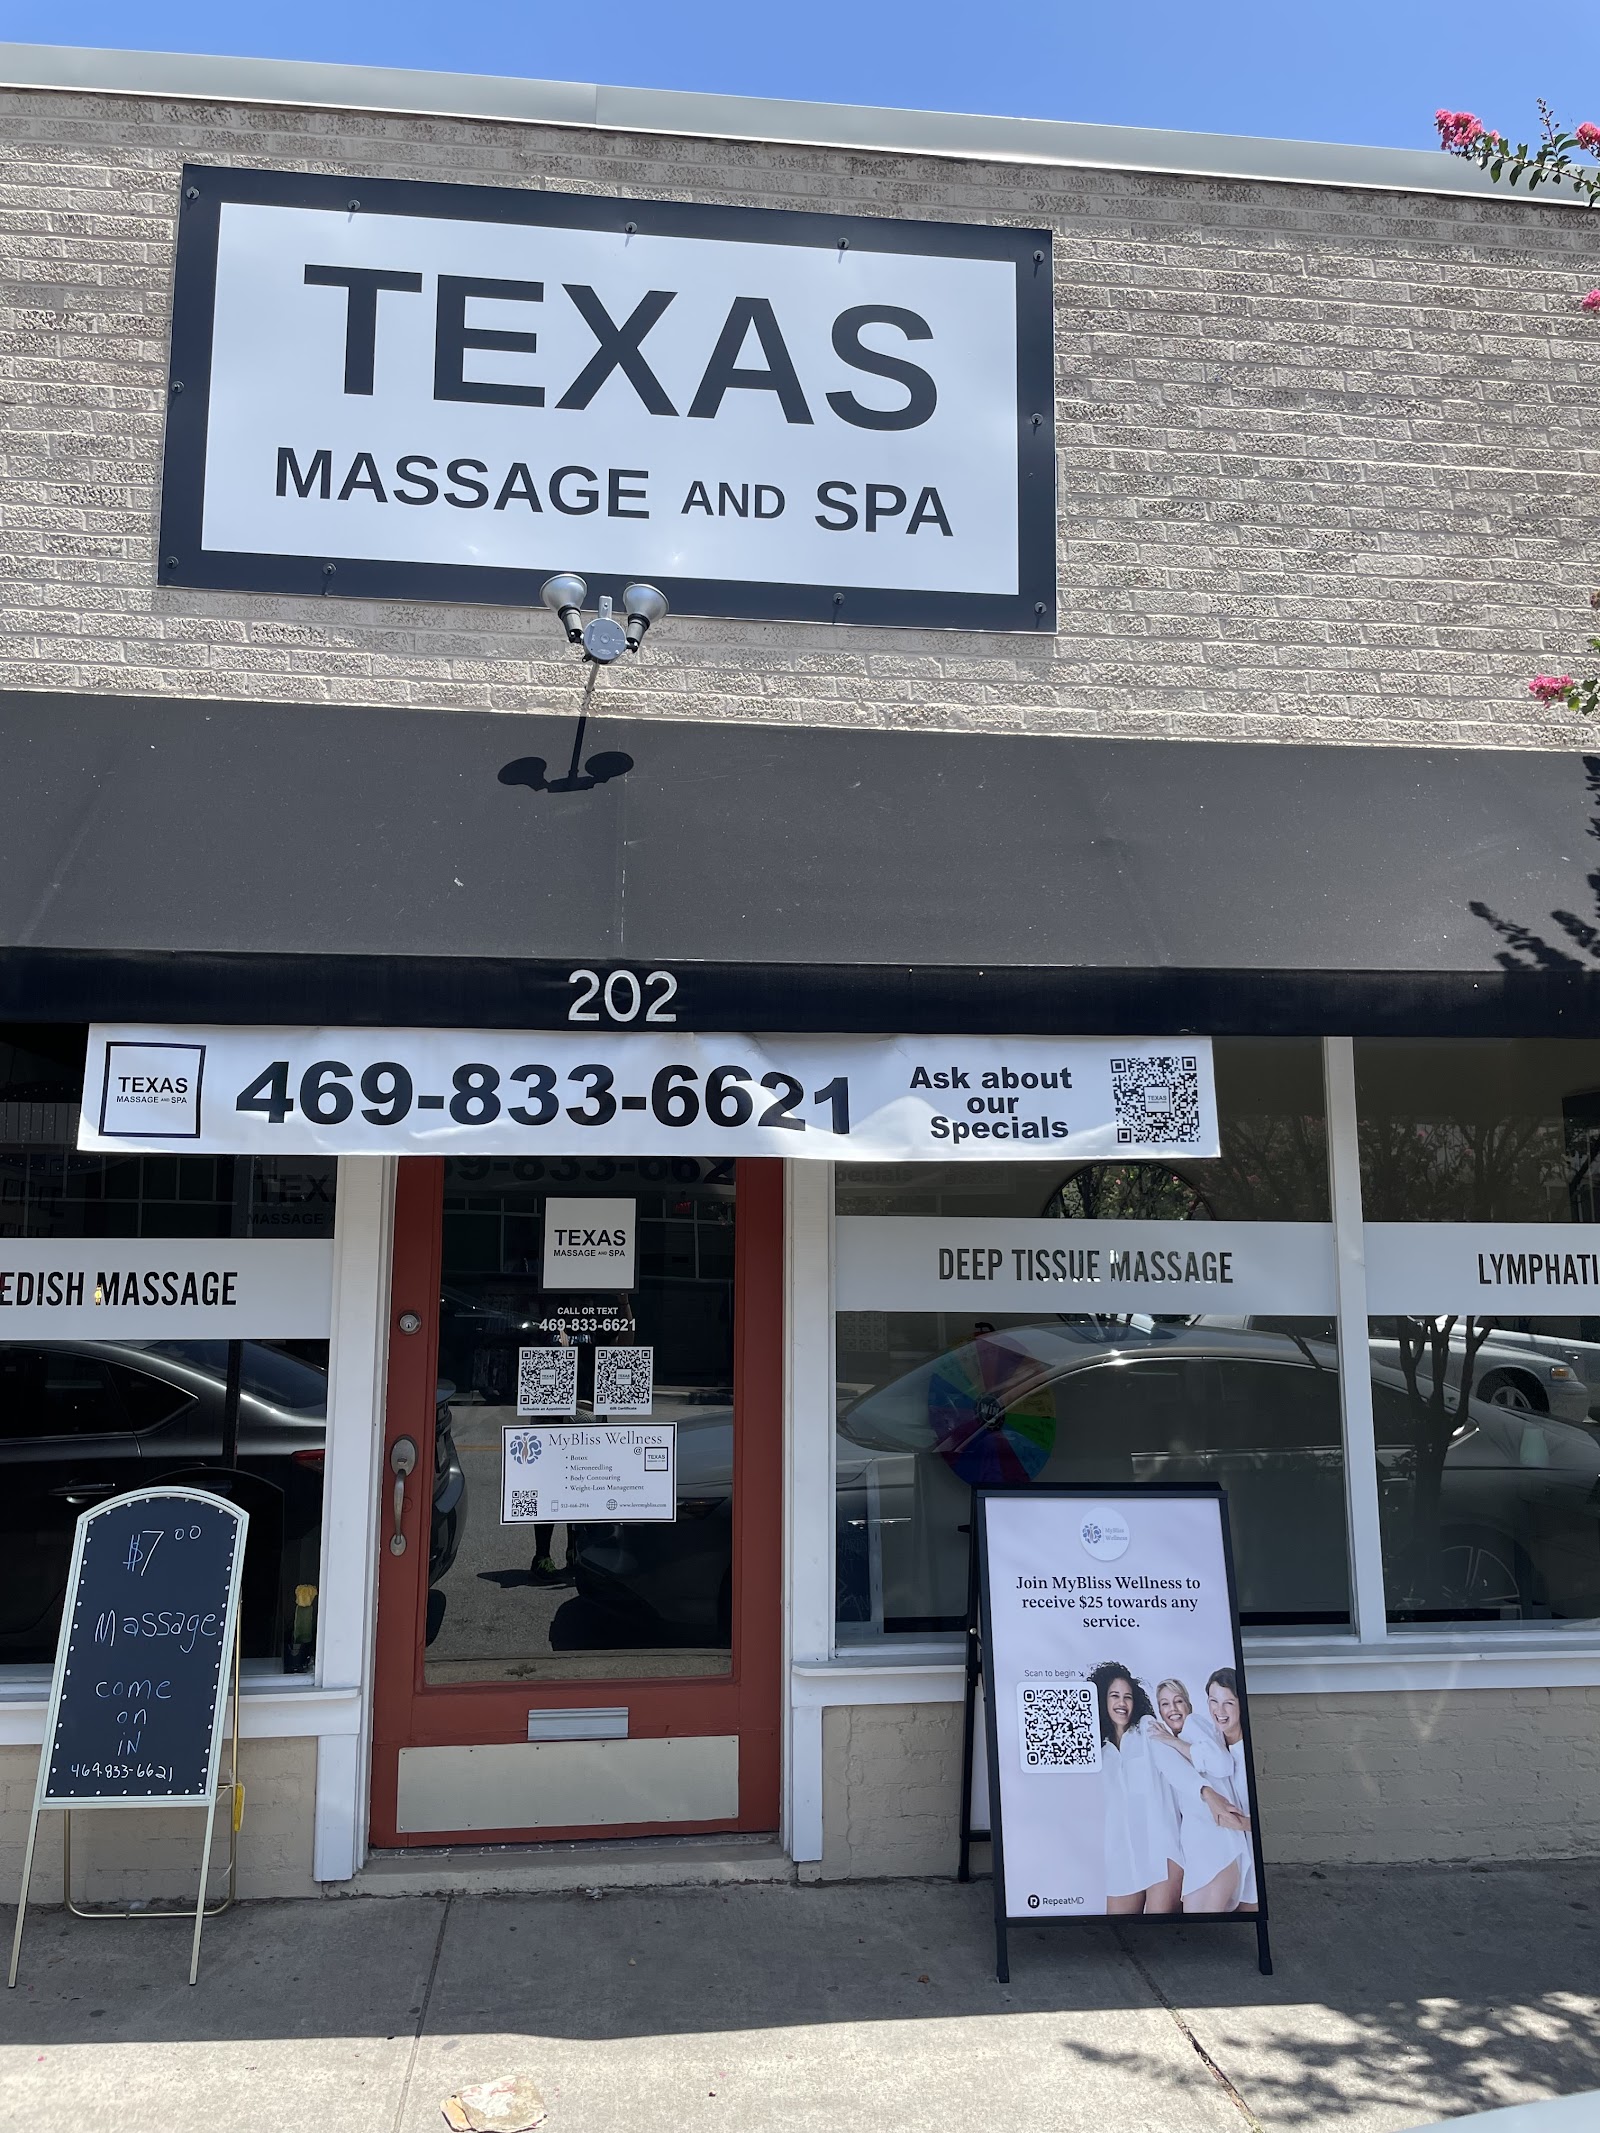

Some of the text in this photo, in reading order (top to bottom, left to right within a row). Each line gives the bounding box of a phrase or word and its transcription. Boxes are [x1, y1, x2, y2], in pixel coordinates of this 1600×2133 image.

[304, 264, 938, 432] TEXAS
[276, 447, 954, 538] MASSAGE AND SPA
[568, 969, 677, 1022] 202
[118, 1077, 188, 1093] TEXAS
[910, 1066, 1072, 1089] Ask about
[117, 1096, 159, 1104] MASSAGE
[171, 1096, 187, 1104] SPA
[236, 1061, 850, 1134] 469-833-6621
[967, 1096, 1019, 1114] our
[931, 1116, 1068, 1144] Specials
[554, 1230, 626, 1246] TEXAS
[939, 1248, 1233, 1284] DEEP TISSUE MASSAGE
[1478, 1254, 1600, 1285] LYMPHATI
[96, 1272, 238, 1306] MASSAGE
[539, 1318, 636, 1331] 469-833-6621
[548, 1431, 662, 1450] MyBliss Wellness
[633, 1447, 642, 1456] @
[570, 1464, 612, 1472] Microneedling
[586, 1474, 621, 1482] Contouring
[607, 1484, 644, 1492] Management
[1016, 1576, 1200, 1592] Join MyBliss Wellness to
[1022, 1595, 1198, 1612] receive $25 towards any
[1083, 1615, 1140, 1628] service.
[94, 1610, 217, 1654] Massage
[1054, 1669, 1076, 1678] begin
[95, 1679, 171, 1698] come
[117, 1709, 146, 1724] on
[1043, 1897, 1084, 1906] RepeatMD
